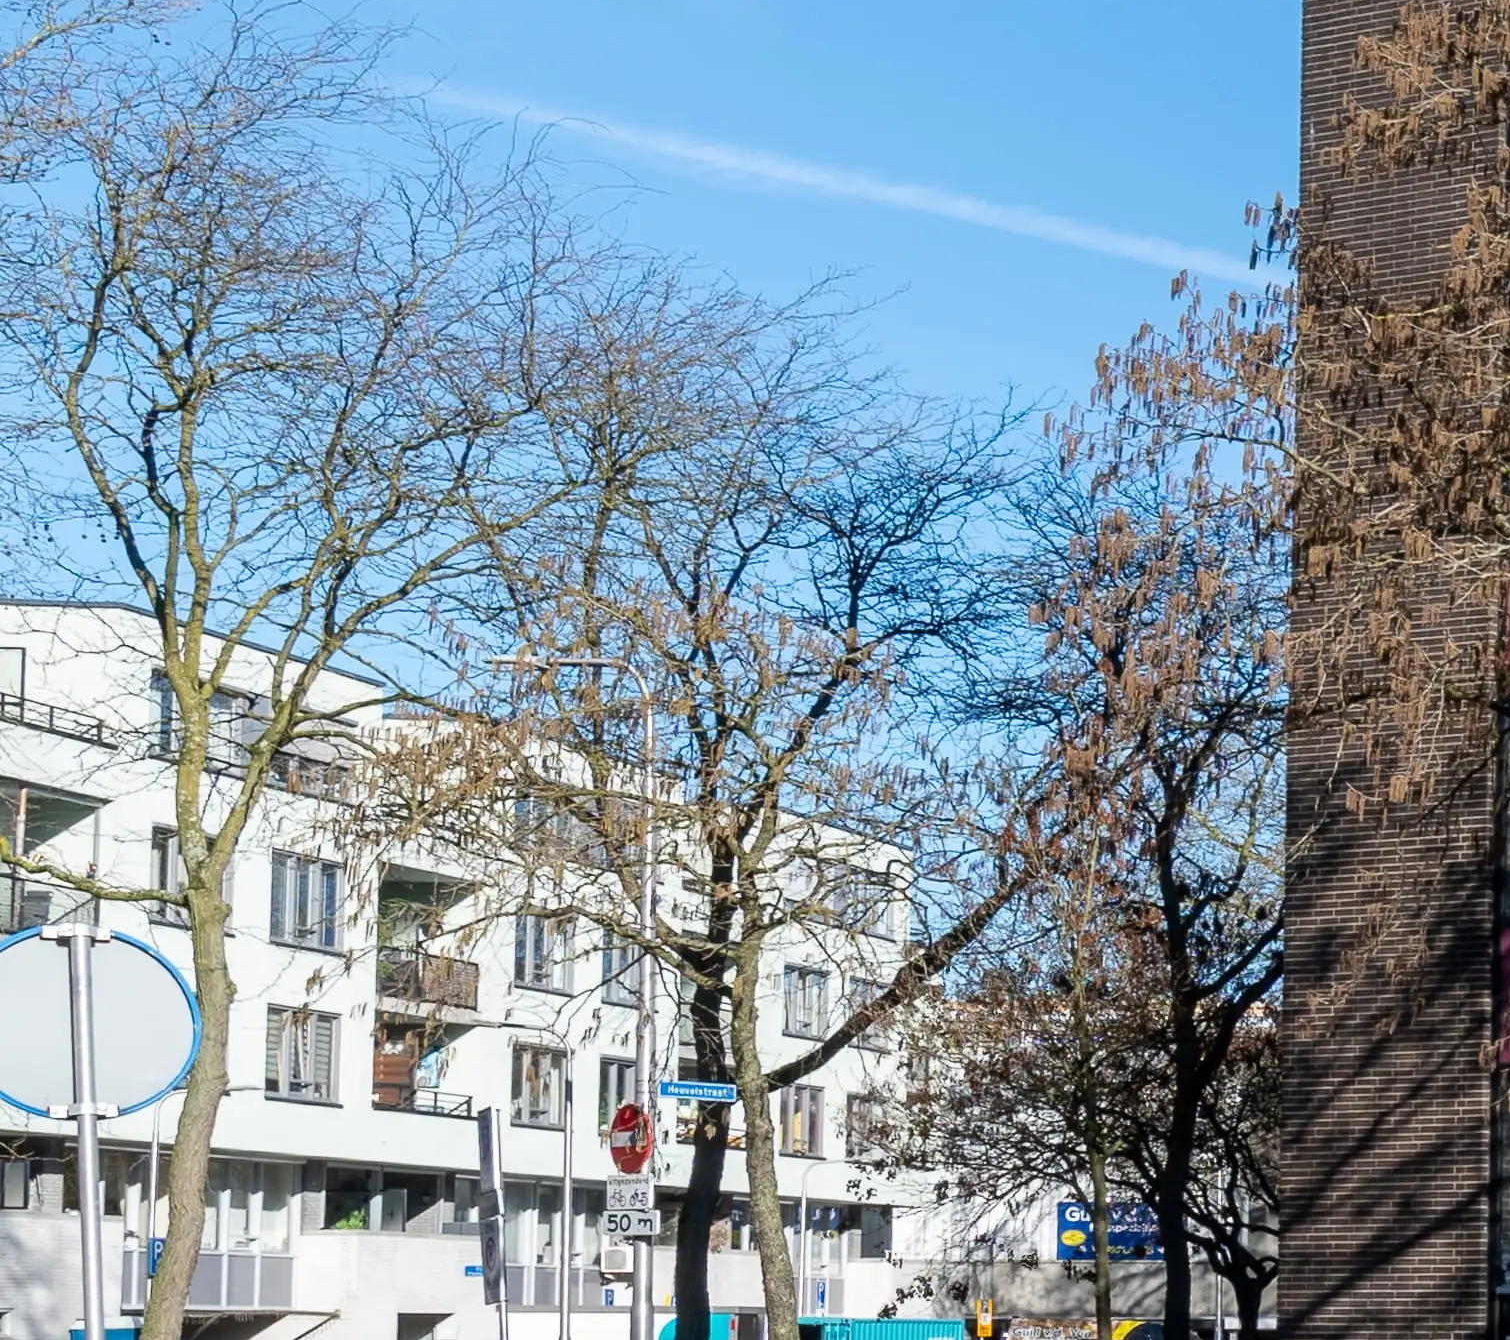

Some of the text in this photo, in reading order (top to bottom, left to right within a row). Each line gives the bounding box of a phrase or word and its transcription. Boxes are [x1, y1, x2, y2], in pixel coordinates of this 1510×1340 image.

[667, 1085, 728, 1097] Heuvelstraat
[607, 1215, 653, 1232] 50 m
